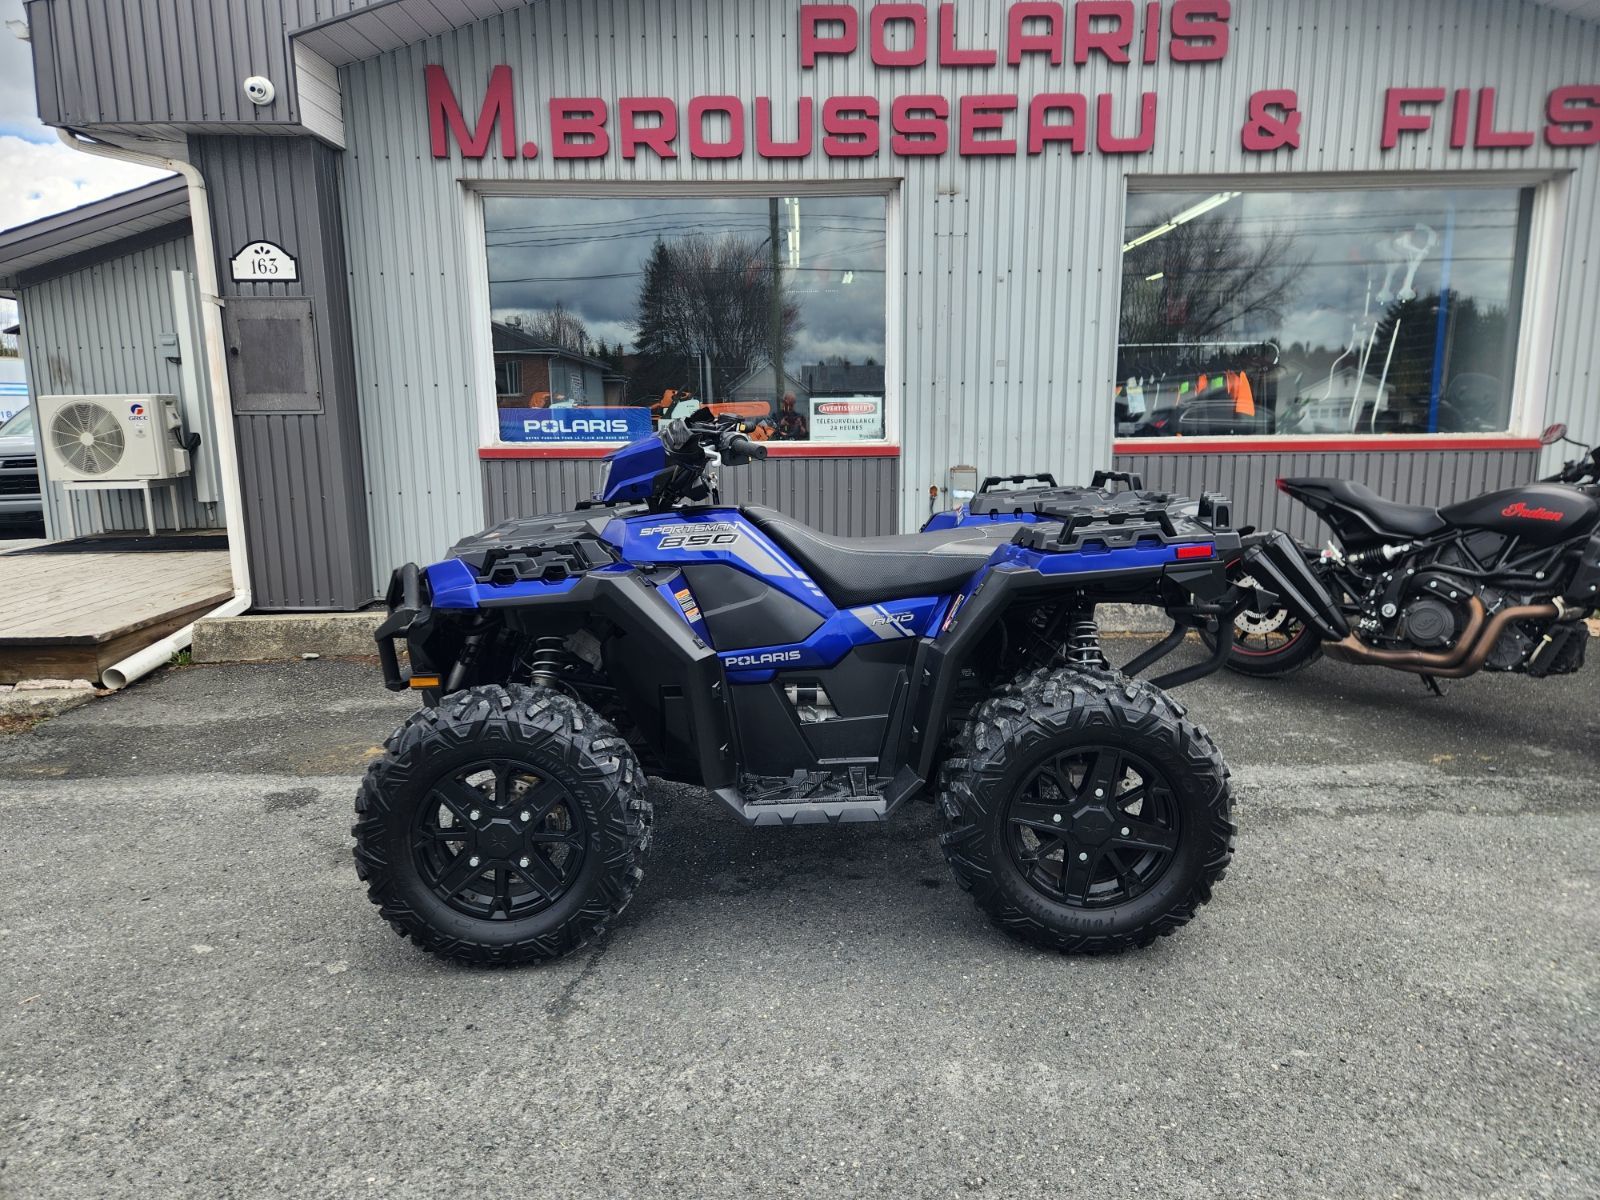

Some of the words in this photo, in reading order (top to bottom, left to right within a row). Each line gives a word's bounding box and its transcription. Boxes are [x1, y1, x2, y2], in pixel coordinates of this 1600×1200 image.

[800, 0, 1231, 69] POLARIS
[1241, 89, 1302, 151] &
[1380, 84, 1600, 150] FILS
[251, 258, 278, 274] 163
[523, 419, 629, 433] POLARIS
[1501, 502, 1564, 522] Indian
[639, 523, 739, 537] SPORTSMAN
[656, 532, 741, 550] 850
[724, 650, 801, 667] POLARIS
